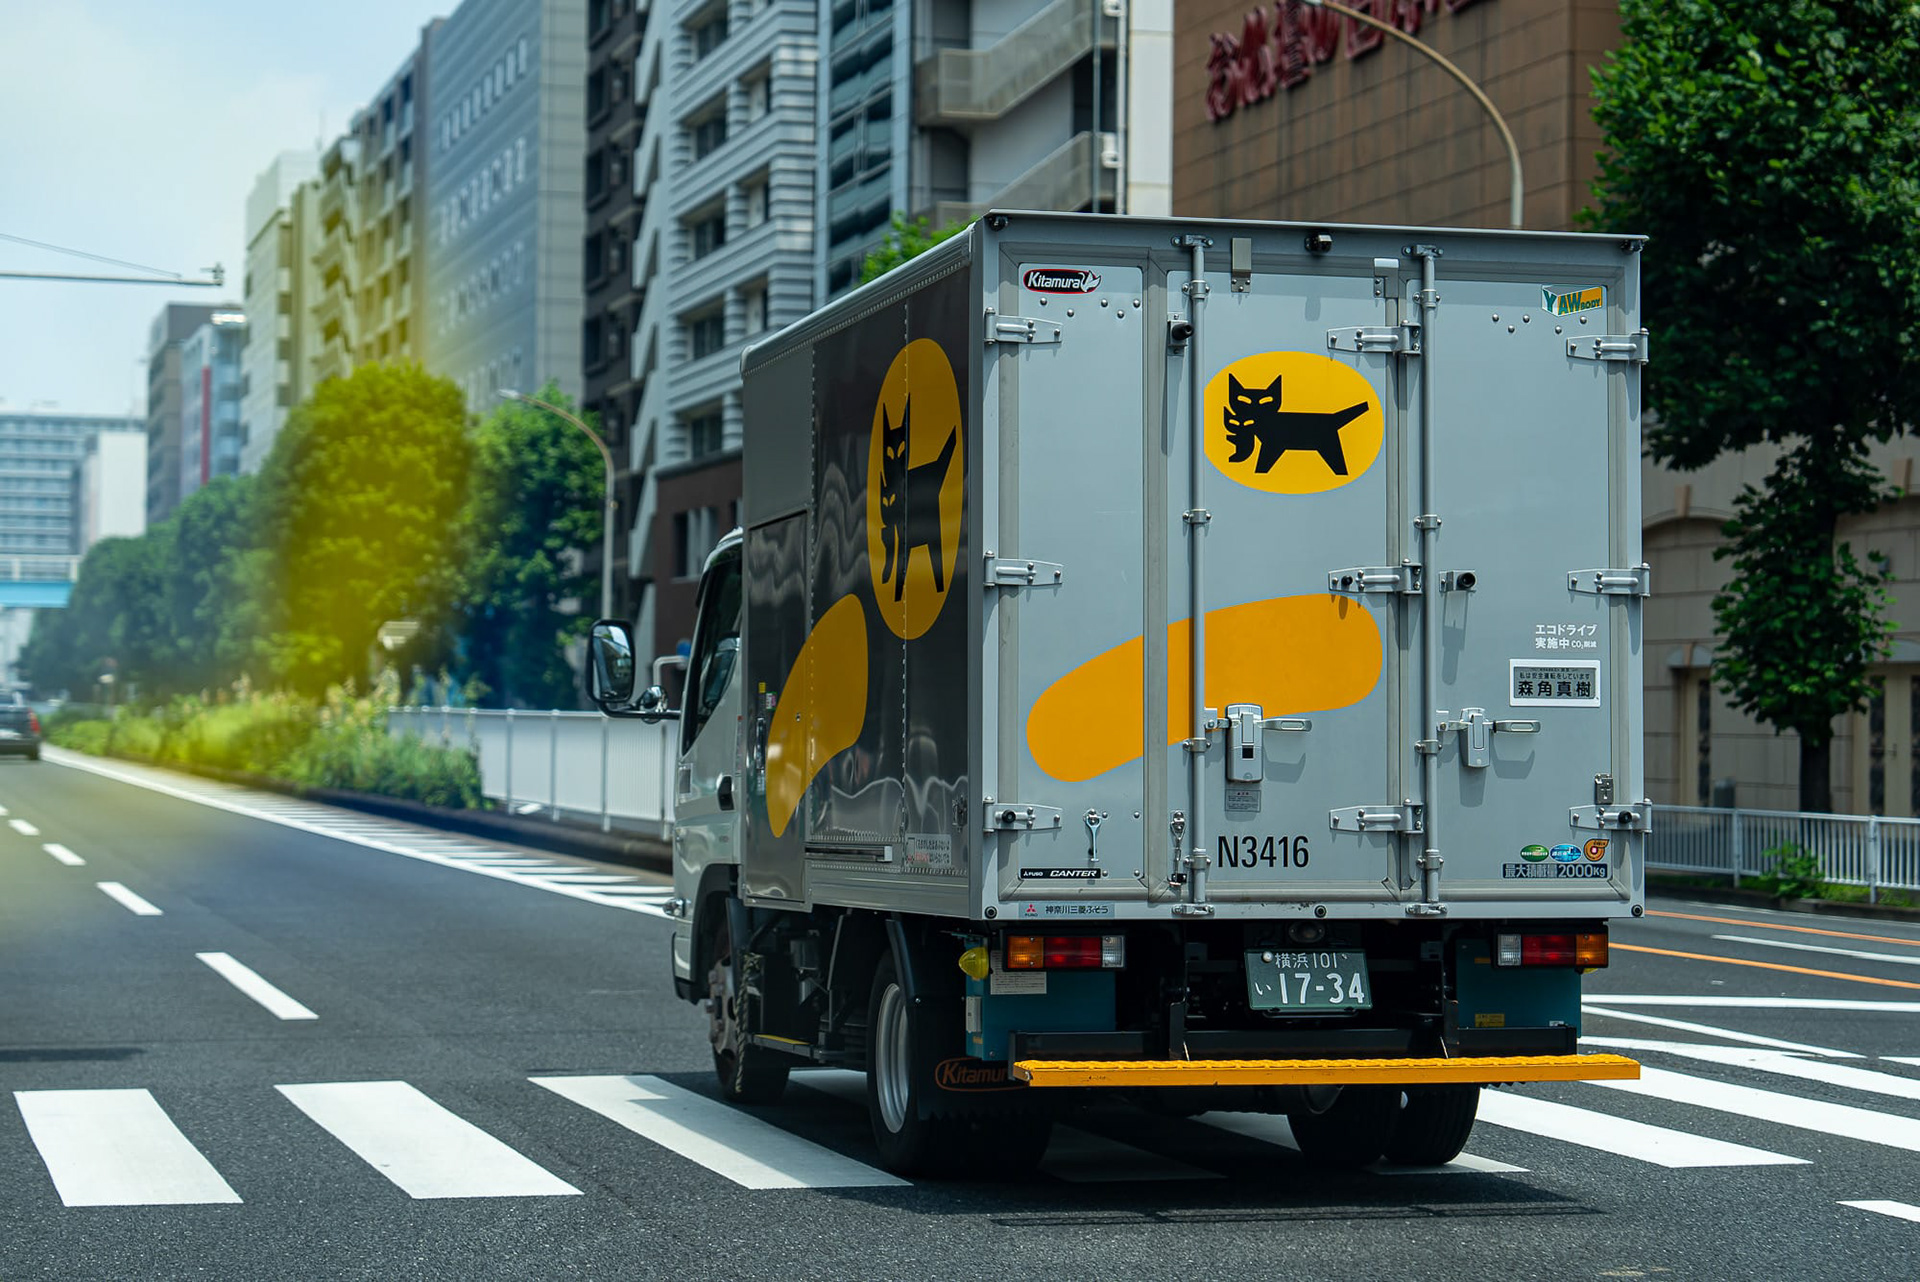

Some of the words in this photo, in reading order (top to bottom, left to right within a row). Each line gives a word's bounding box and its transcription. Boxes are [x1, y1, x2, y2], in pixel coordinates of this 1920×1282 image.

[1027, 271, 1080, 288] Kitamura
[1535, 624, 1598, 636] エコドライブ
[1535, 637, 1570, 649] 実施中
[1518, 680, 1591, 697] 森角真樹
[1218, 835, 1309, 868] N3416
[1045, 905, 1108, 914] 神奈川三菱ふそう
[1254, 981, 1272, 996] い
[1279, 972, 1365, 1004] 17-34
[942, 1061, 1009, 1084] Kitamur
